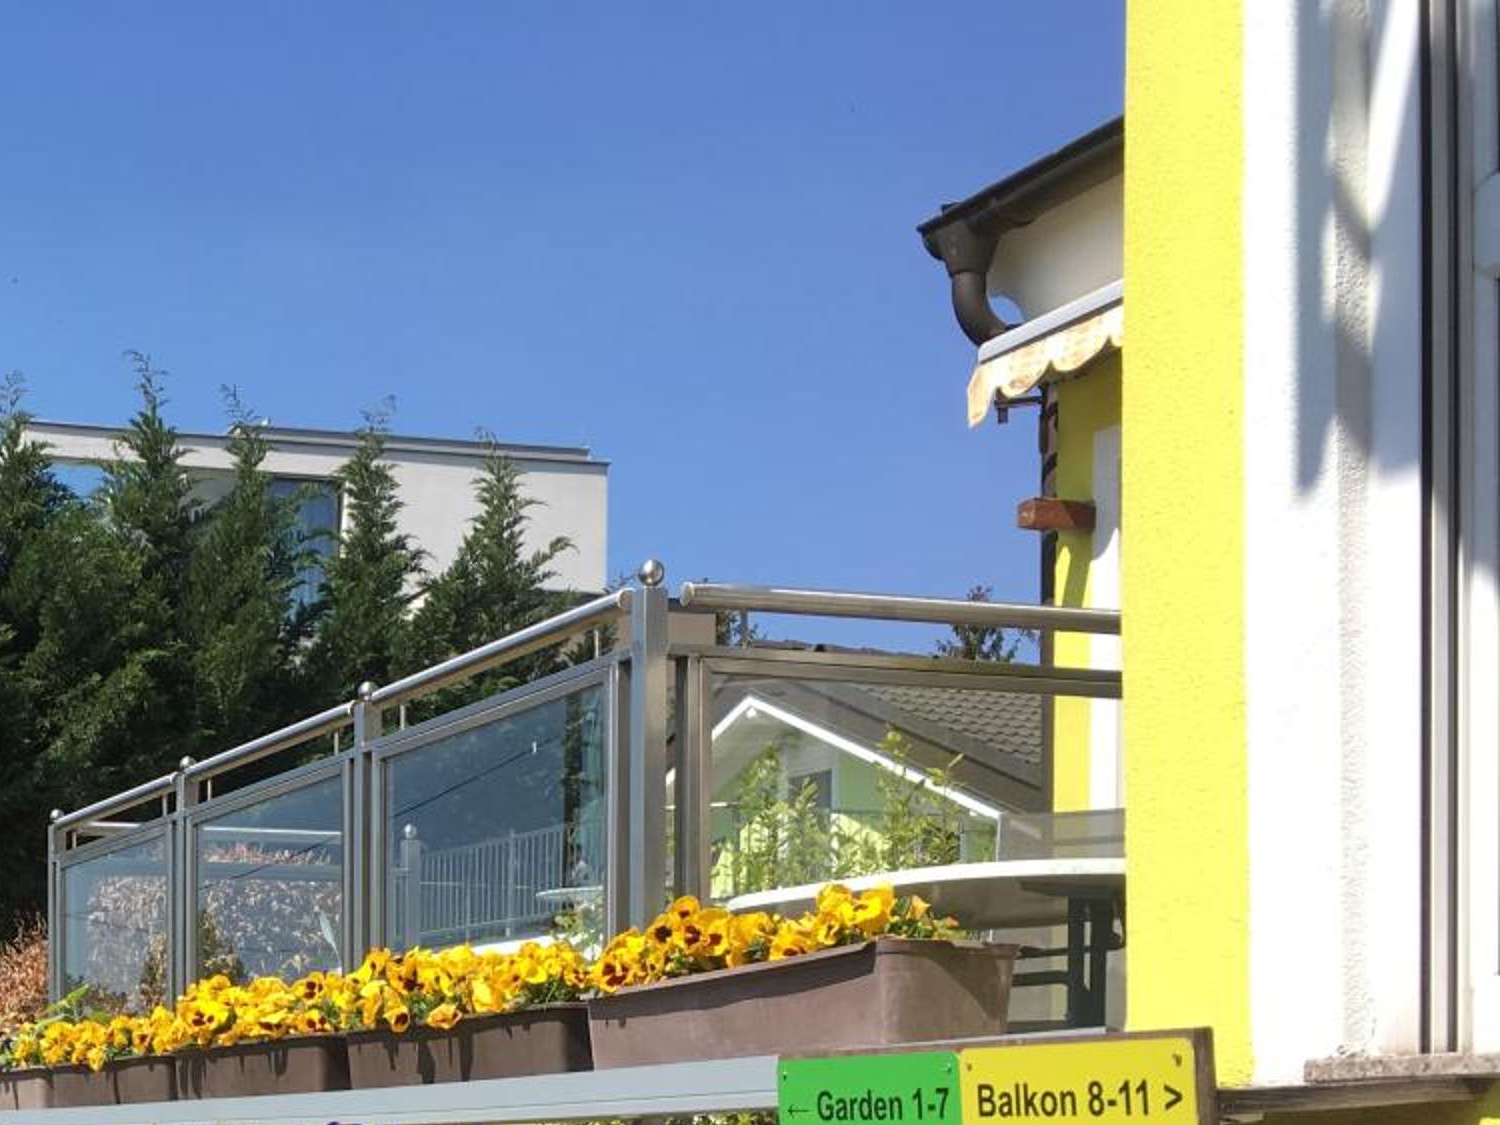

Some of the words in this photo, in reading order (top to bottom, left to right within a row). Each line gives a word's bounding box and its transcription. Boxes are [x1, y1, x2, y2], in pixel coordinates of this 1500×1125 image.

[817, 1090, 903, 1121] Garden
[912, 1088, 950, 1121] 1-7
[977, 1082, 1077, 1118] Balkon
[1088, 1079, 1150, 1116] 8-11
